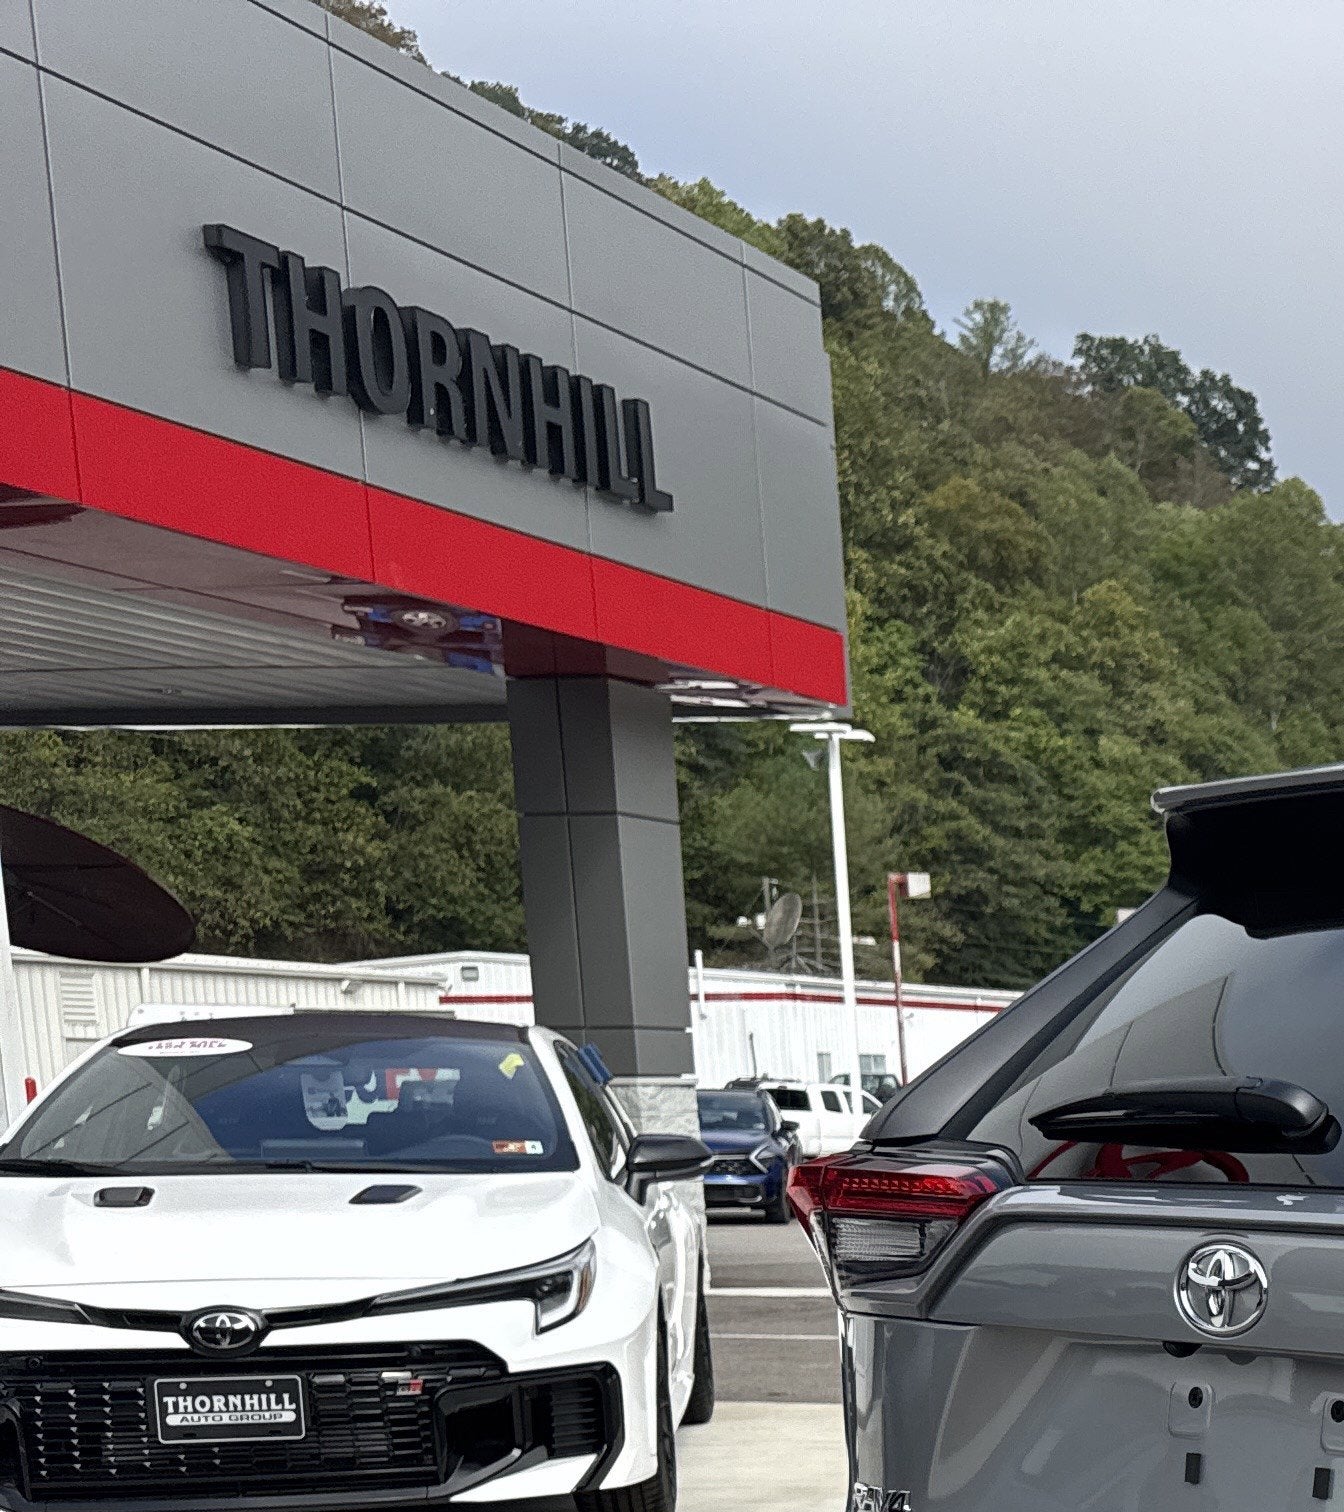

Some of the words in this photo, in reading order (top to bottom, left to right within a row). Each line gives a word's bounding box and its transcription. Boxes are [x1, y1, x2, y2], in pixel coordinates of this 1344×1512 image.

[204, 224, 673, 513] THORNHILL
[162, 1392, 297, 1414] THORNHILL
[179, 1414, 223, 1424] AUTO
[228, 1411, 284, 1422] GROUP
